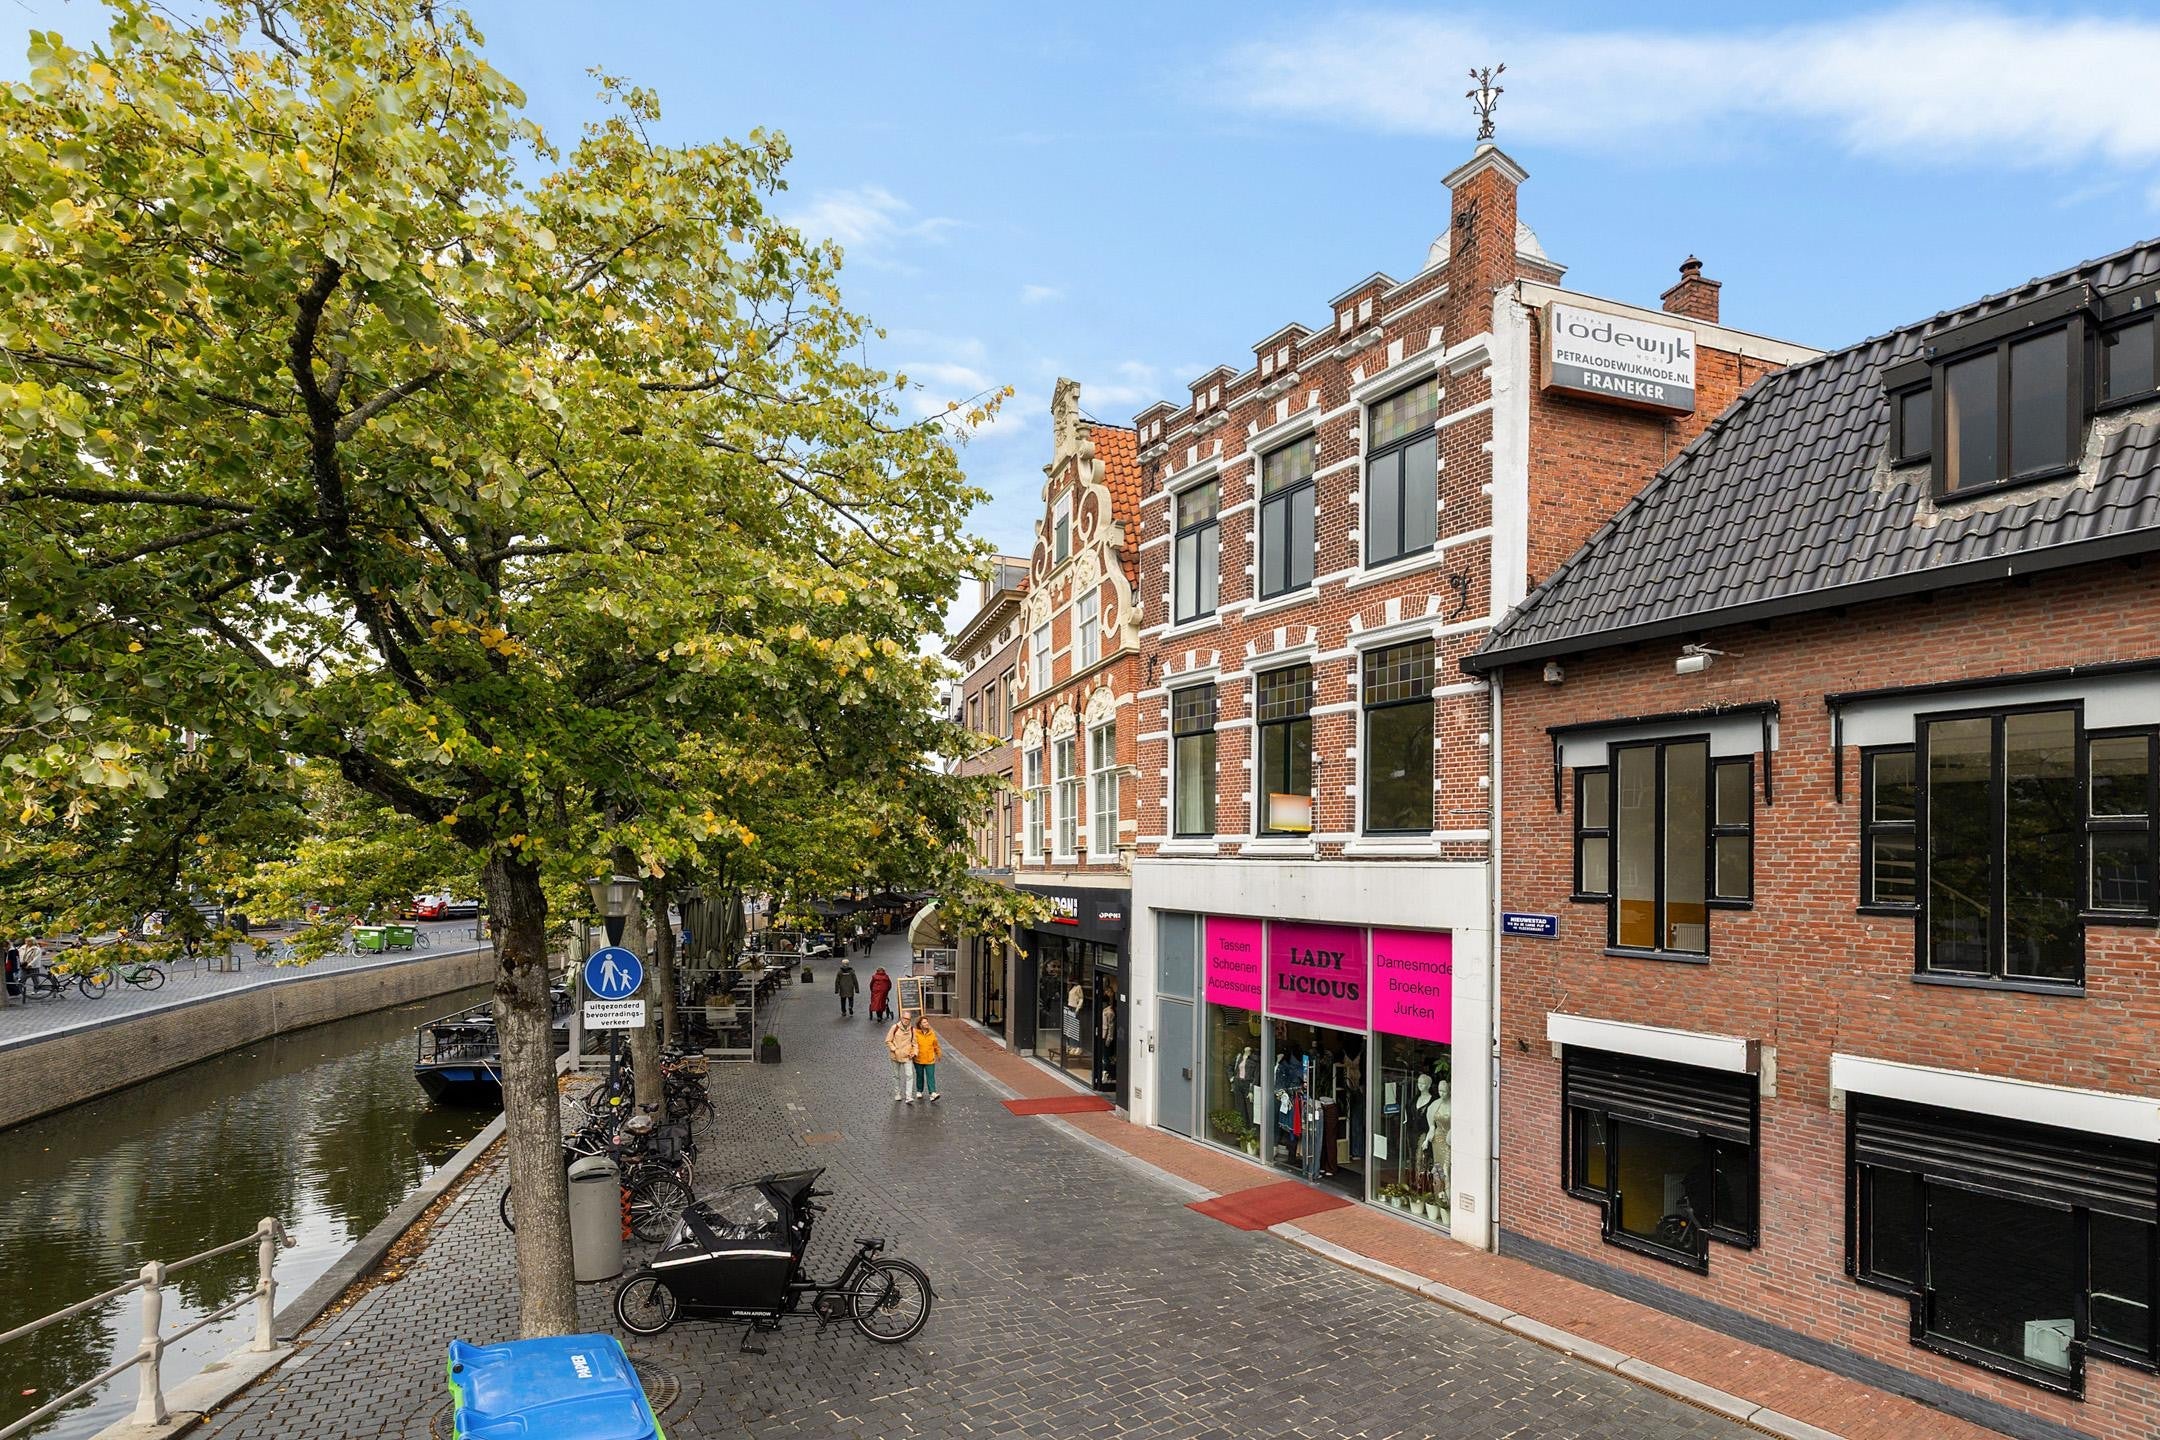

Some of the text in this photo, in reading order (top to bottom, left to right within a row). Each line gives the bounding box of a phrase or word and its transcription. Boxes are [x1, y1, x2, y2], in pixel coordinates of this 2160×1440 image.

[1556, 312, 1690, 364] lodewijk
[1557, 349, 1690, 384] PETRALODEWIJKMODE.NL
[1583, 371, 1664, 400] FRANEKER
[1219, 938, 1250, 952] Tassen
[1212, 957, 1257, 974] Schoenen
[1290, 948, 1346, 970] LADY
[1377, 955, 1453, 975] Damesmode
[1208, 977, 1262, 995] Accessoires
[1278, 973, 1360, 1001] LICIOUS
[1389, 978, 1440, 997] Broeken
[590, 1003, 640, 1011] uitgezonderd
[1393, 1001, 1435, 1019] Jurken
[571, 1354, 592, 1378] PAPIER
